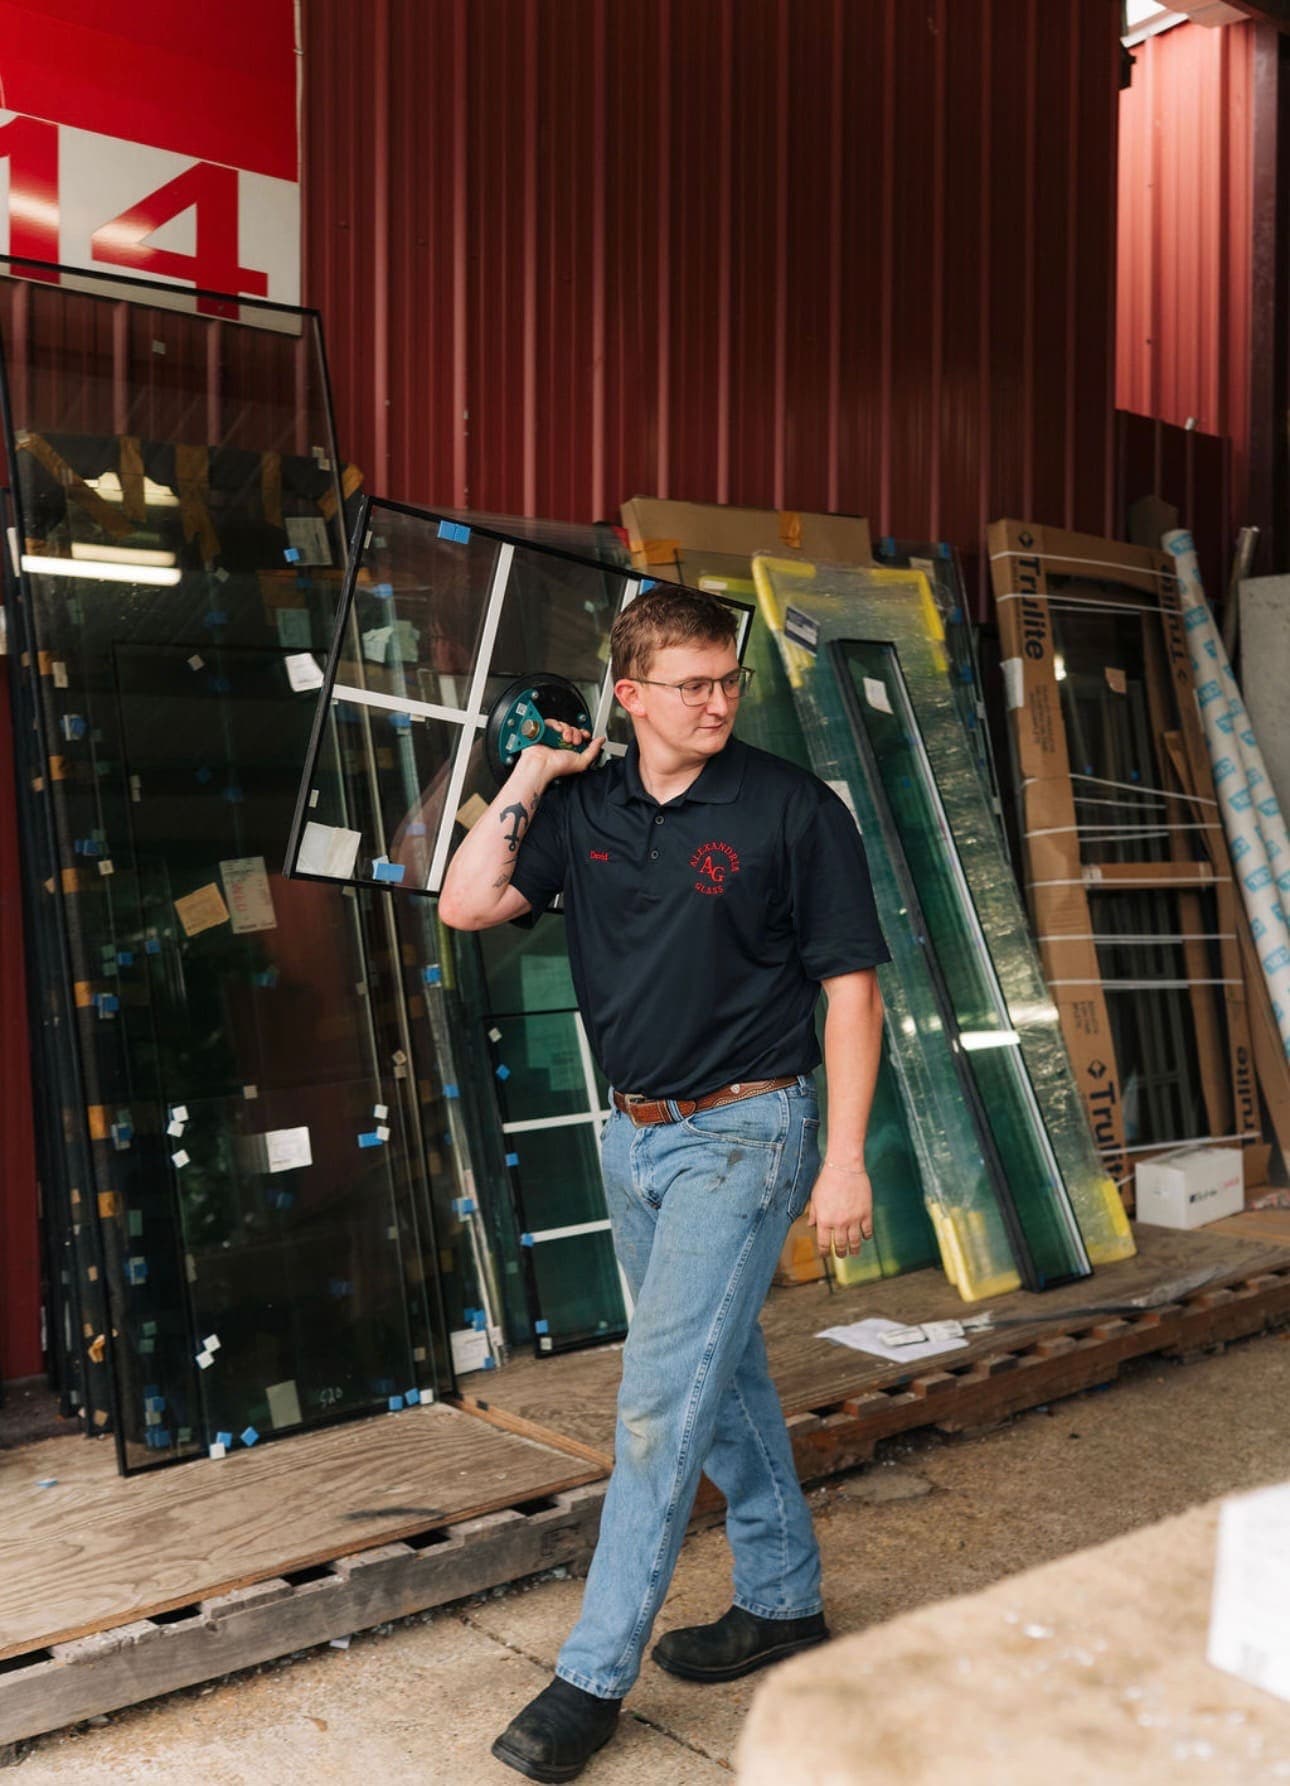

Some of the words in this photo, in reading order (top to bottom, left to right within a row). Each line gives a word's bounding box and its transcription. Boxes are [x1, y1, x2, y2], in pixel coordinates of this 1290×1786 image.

[1019, 556, 1046, 660] Trulite
[695, 882, 724, 895] GLASS
[1090, 1081, 1123, 1192] Trulit
